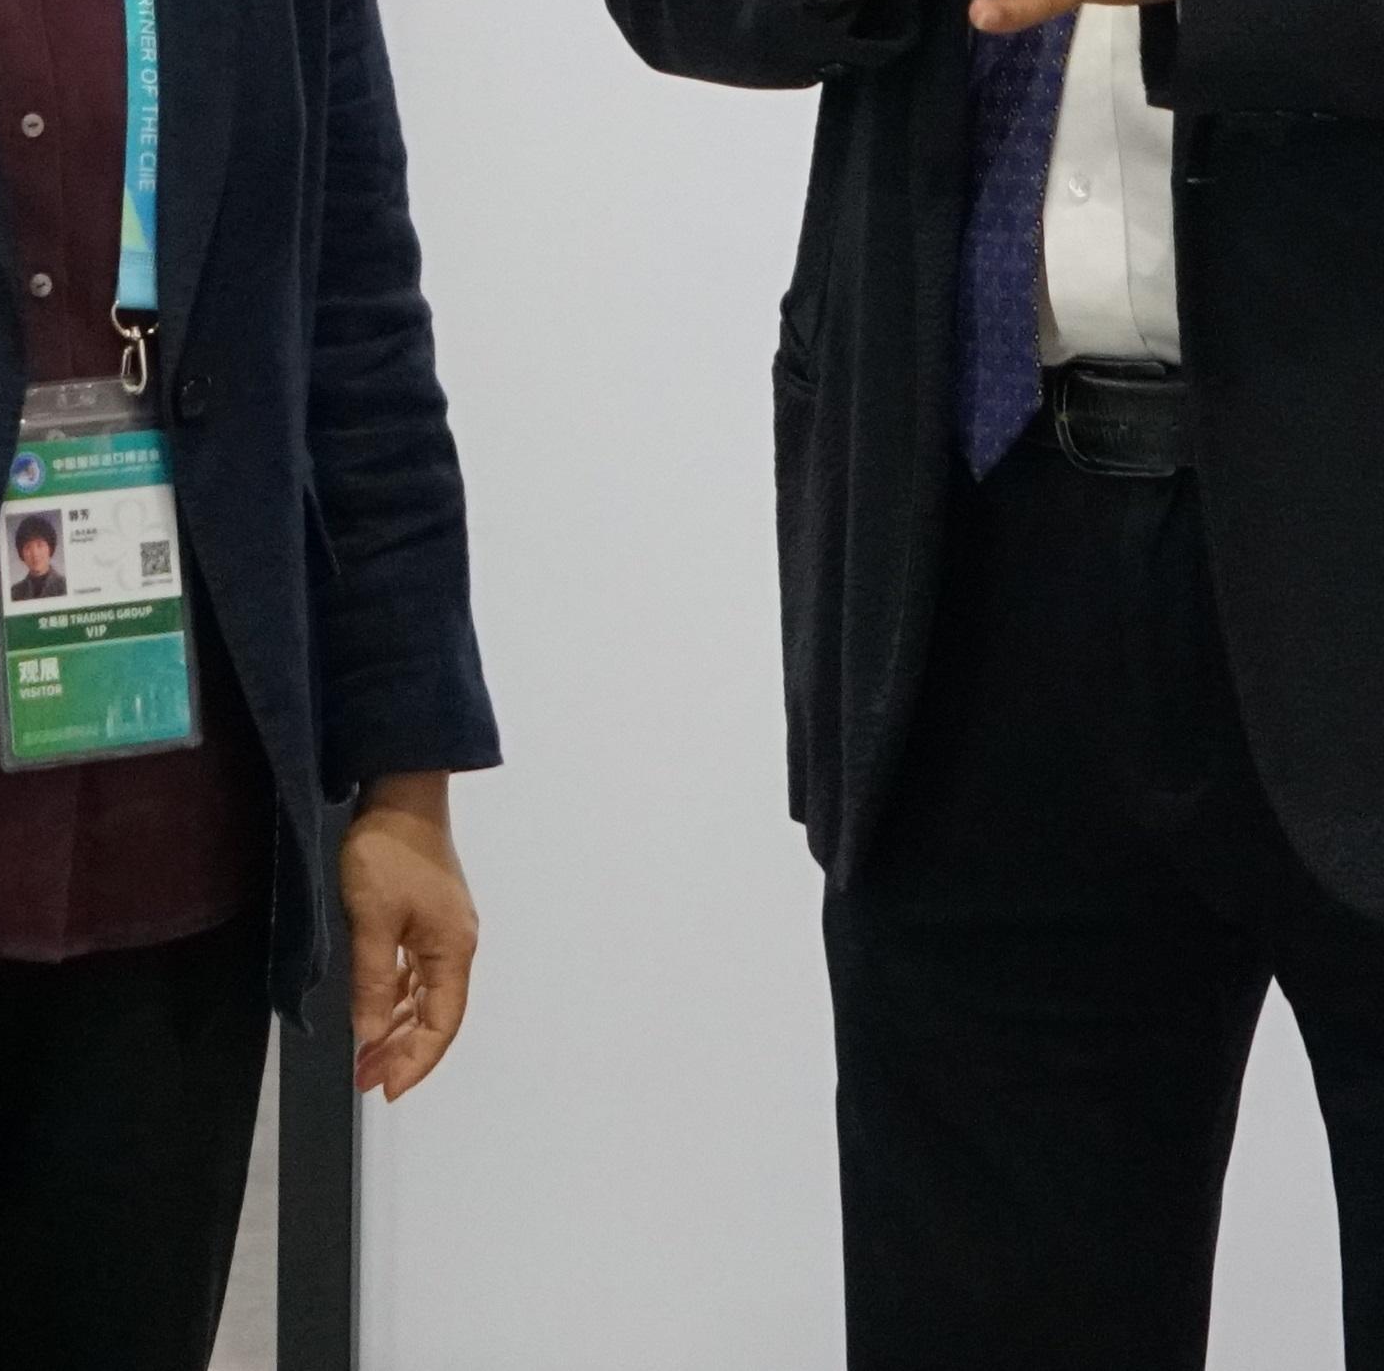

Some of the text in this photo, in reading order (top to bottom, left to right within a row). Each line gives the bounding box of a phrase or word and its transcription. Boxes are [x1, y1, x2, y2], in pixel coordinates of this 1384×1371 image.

[140, 68, 158, 101] OF
[140, 106, 159, 146] THE
[138, 152, 157, 192] CIIE
[69, 608, 115, 625] TRADING
[116, 605, 153, 620] GROUP
[85, 624, 108, 638] VIP
